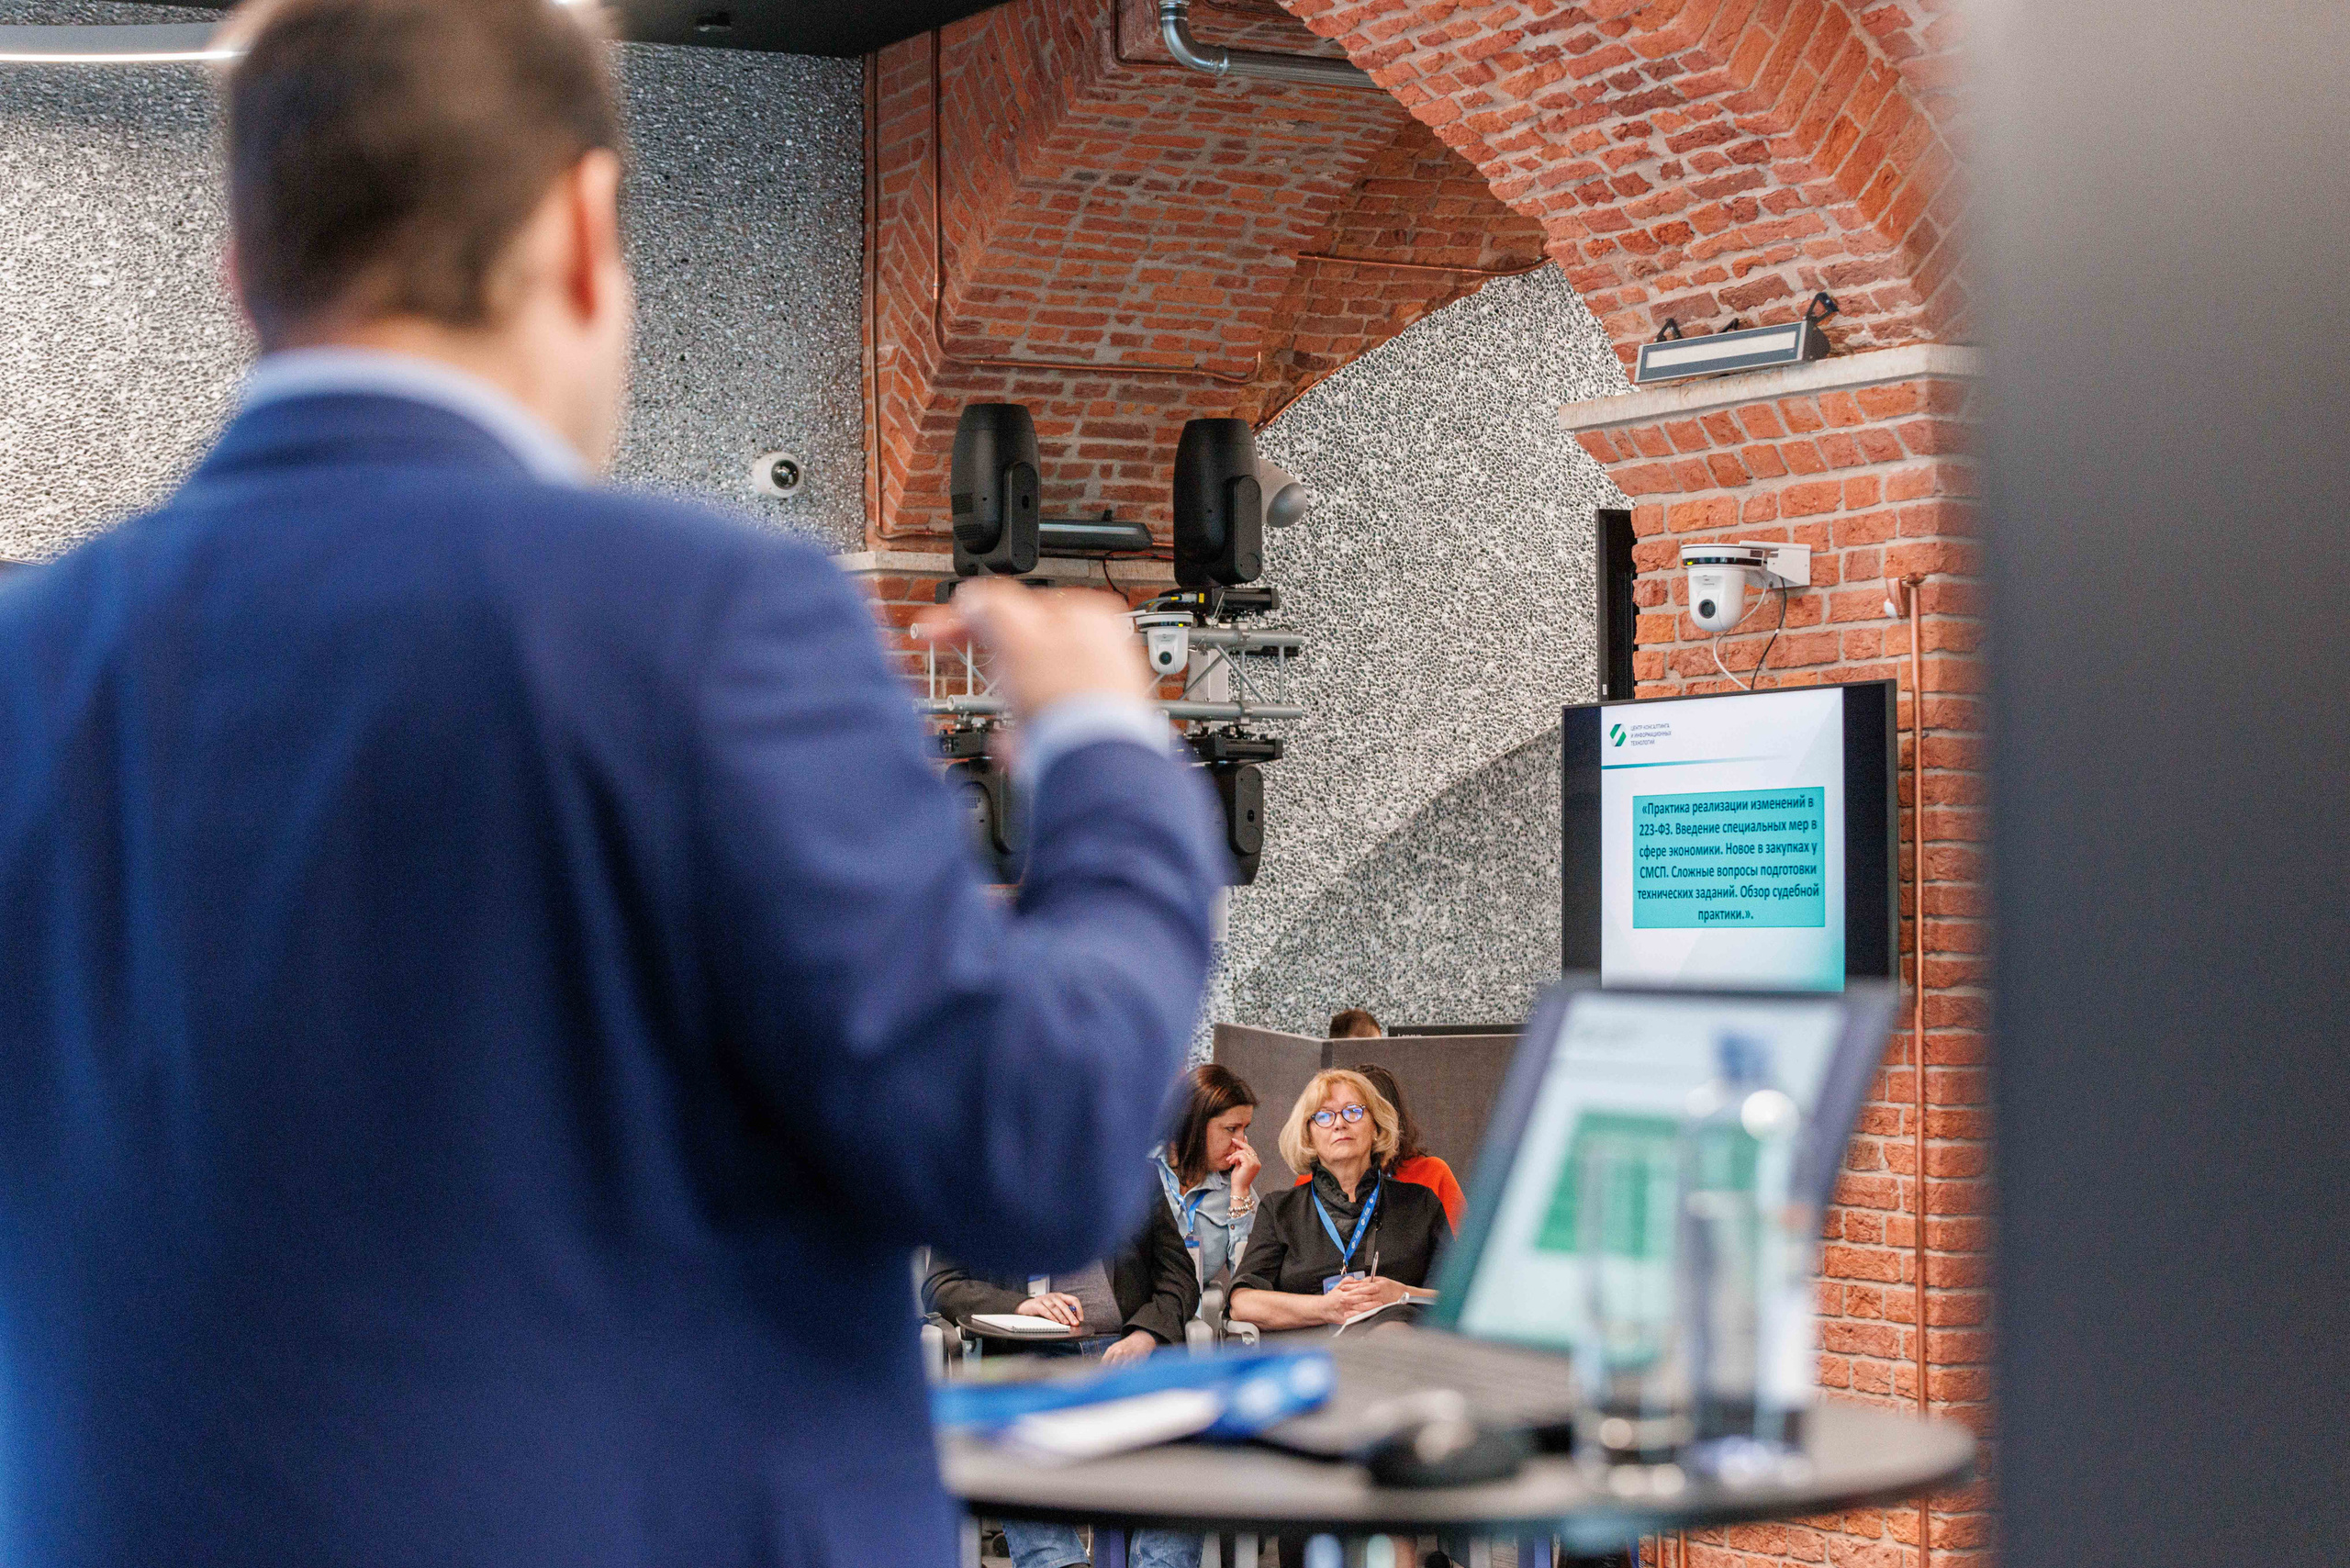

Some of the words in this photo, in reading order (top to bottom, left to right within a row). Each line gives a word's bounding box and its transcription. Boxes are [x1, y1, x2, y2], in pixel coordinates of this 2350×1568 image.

[1642, 802, 1689, 817] «Практика
[1693, 801, 1748, 815] реализации
[1751, 795, 1805, 811] изменений
[1808, 798, 1813, 807] в
[1639, 823, 1673, 835] 223-ФЗ.
[1675, 823, 1720, 835] Введение
[1723, 821, 1786, 834] специальных
[1789, 821, 1808, 833] мер
[1811, 820, 1817, 829] в
[1639, 845, 1666, 859] сфере
[1669, 845, 1723, 857] экономики.
[1726, 843, 1754, 855] Новое
[1758, 844, 1763, 853] в
[1765, 842, 1809, 857] закупках
[1811, 842, 1817, 855] у
[1640, 867, 1669, 878] СМСП.
[1672, 866, 1714, 878] Сложные
[1718, 866, 1757, 879] вопросы
[1761, 865, 1817, 878] подготовки
[1638, 887, 1693, 899] технических
[1695, 885, 1738, 900] заданий.
[1740, 886, 1770, 900] Обзор
[1773, 884, 1818, 900] судебной
[1698, 910, 1753, 923] практики.».
